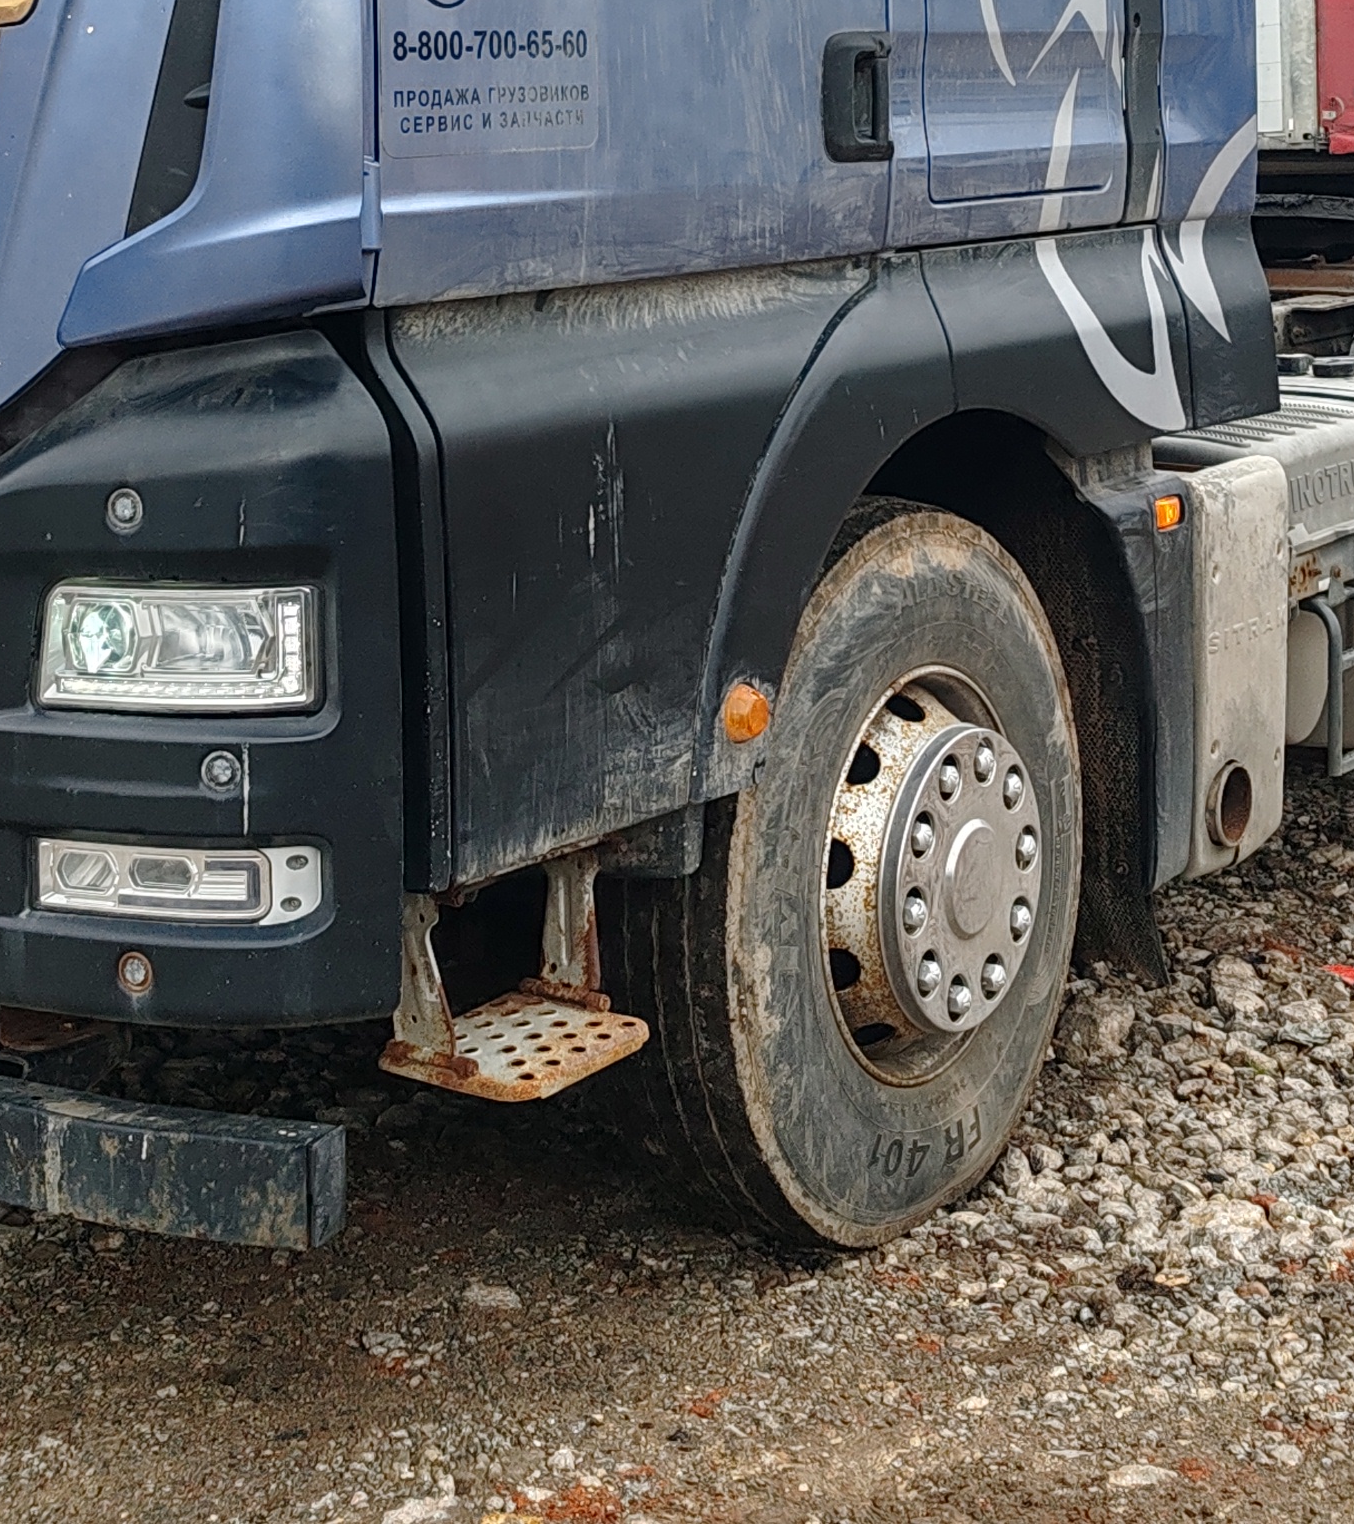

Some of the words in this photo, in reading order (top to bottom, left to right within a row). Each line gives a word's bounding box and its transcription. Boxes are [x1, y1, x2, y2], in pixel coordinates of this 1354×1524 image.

[393, 30, 588, 61] 8-800-700-65-60
[394, 87, 481, 110] ПРОДАЖА
[488, 84, 590, 104] ГРУЗОВИКОВ
[400, 113, 473, 134] СЕРВИС
[482, 113, 492, 130] И
[867, 1132, 932, 1178] 401
